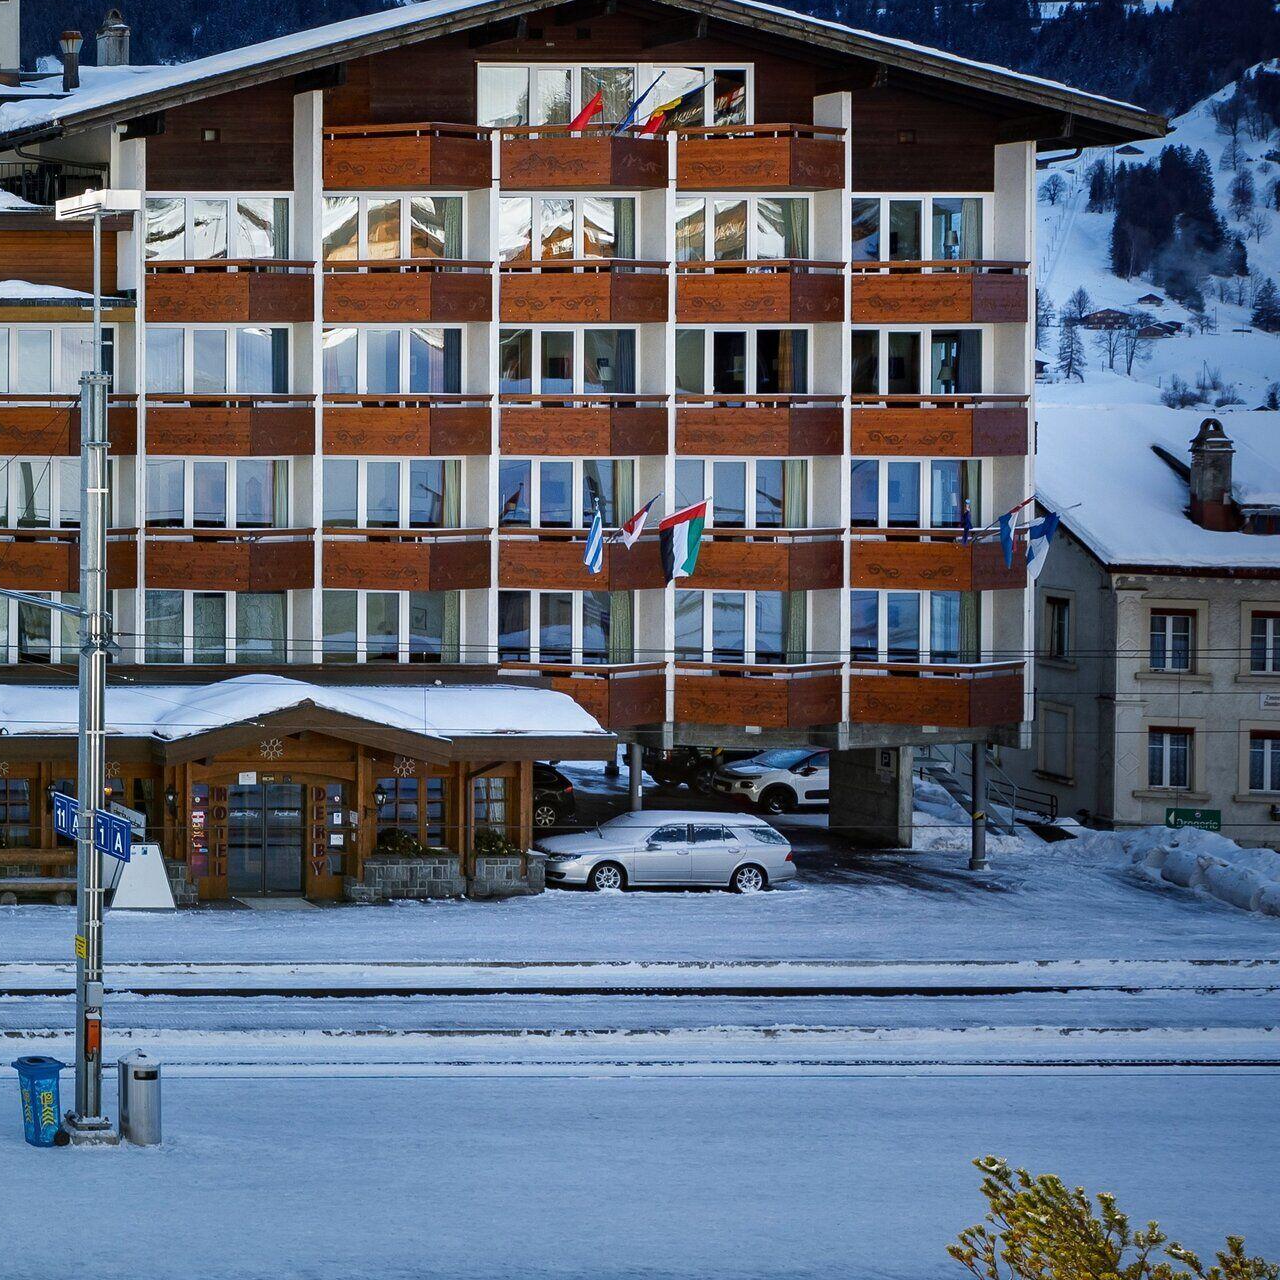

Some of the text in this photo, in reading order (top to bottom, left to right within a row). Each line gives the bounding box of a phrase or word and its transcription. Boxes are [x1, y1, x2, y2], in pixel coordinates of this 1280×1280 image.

[100, 826, 123, 853] 1 A
[214, 786, 228, 876] HOTEL
[311, 786, 326, 876] DERBY
